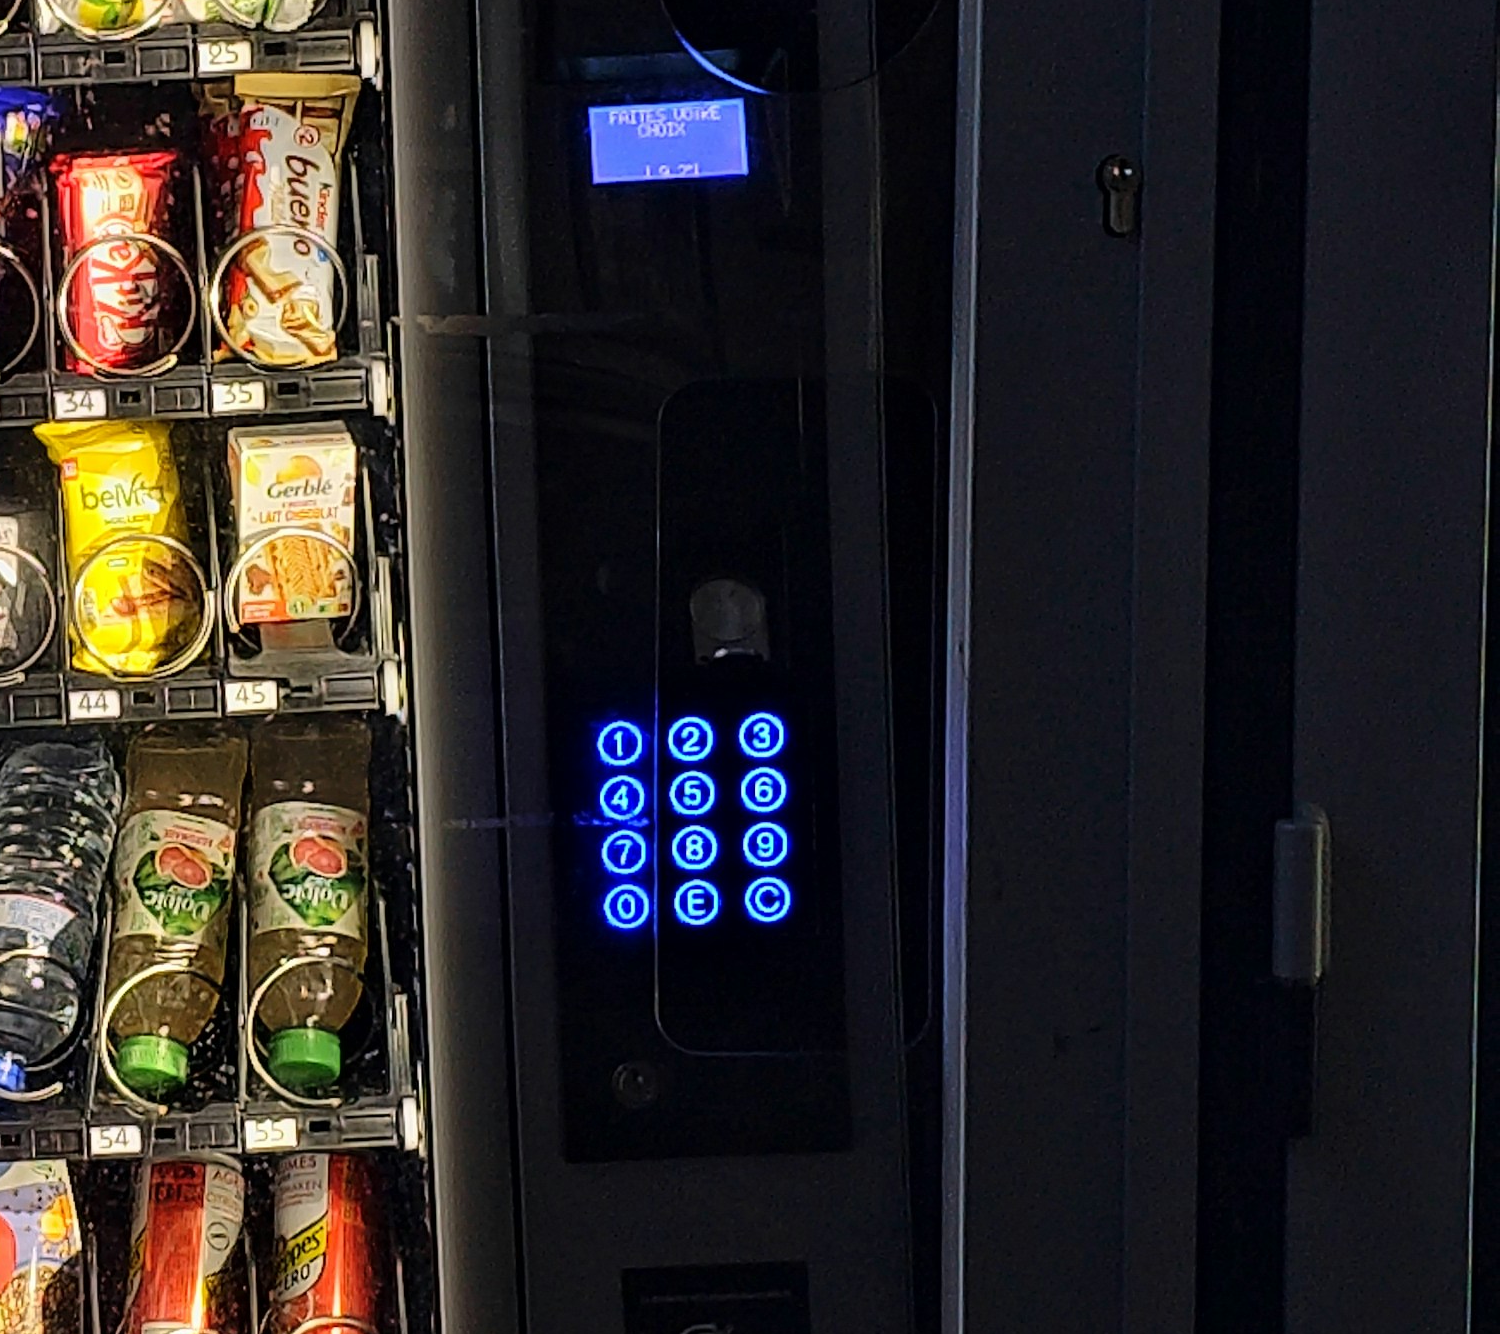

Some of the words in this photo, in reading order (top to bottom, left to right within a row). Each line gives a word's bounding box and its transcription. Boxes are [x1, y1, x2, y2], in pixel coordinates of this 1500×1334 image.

[208, 43, 239, 65] 25
[608, 107, 668, 127] FAITES
[284, 153, 316, 258] bueno
[63, 391, 95, 412] 34
[220, 383, 252, 404] 35
[80, 472, 167, 511] belVita
[267, 478, 333, 499] Gerblé
[77, 693, 110, 714] 44
[235, 684, 266, 706] 45
[613, 730, 624, 758] 1
[681, 726, 701, 753] 2
[752, 722, 771, 749] 3
[611, 785, 629, 812] 4
[683, 780, 702, 807] 5
[754, 776, 774, 803] 6
[613, 839, 634, 866] 7
[685, 834, 704, 861] 8
[756, 831, 775, 858] 9
[143, 889, 211, 921] Volvic
[282, 882, 350, 911] Volvic
[617, 893, 636, 920] 0
[687, 889, 706, 917] E
[755, 885, 781, 913] C
[97, 1129, 131, 1151] 54
[254, 1120, 286, 1143] 55
